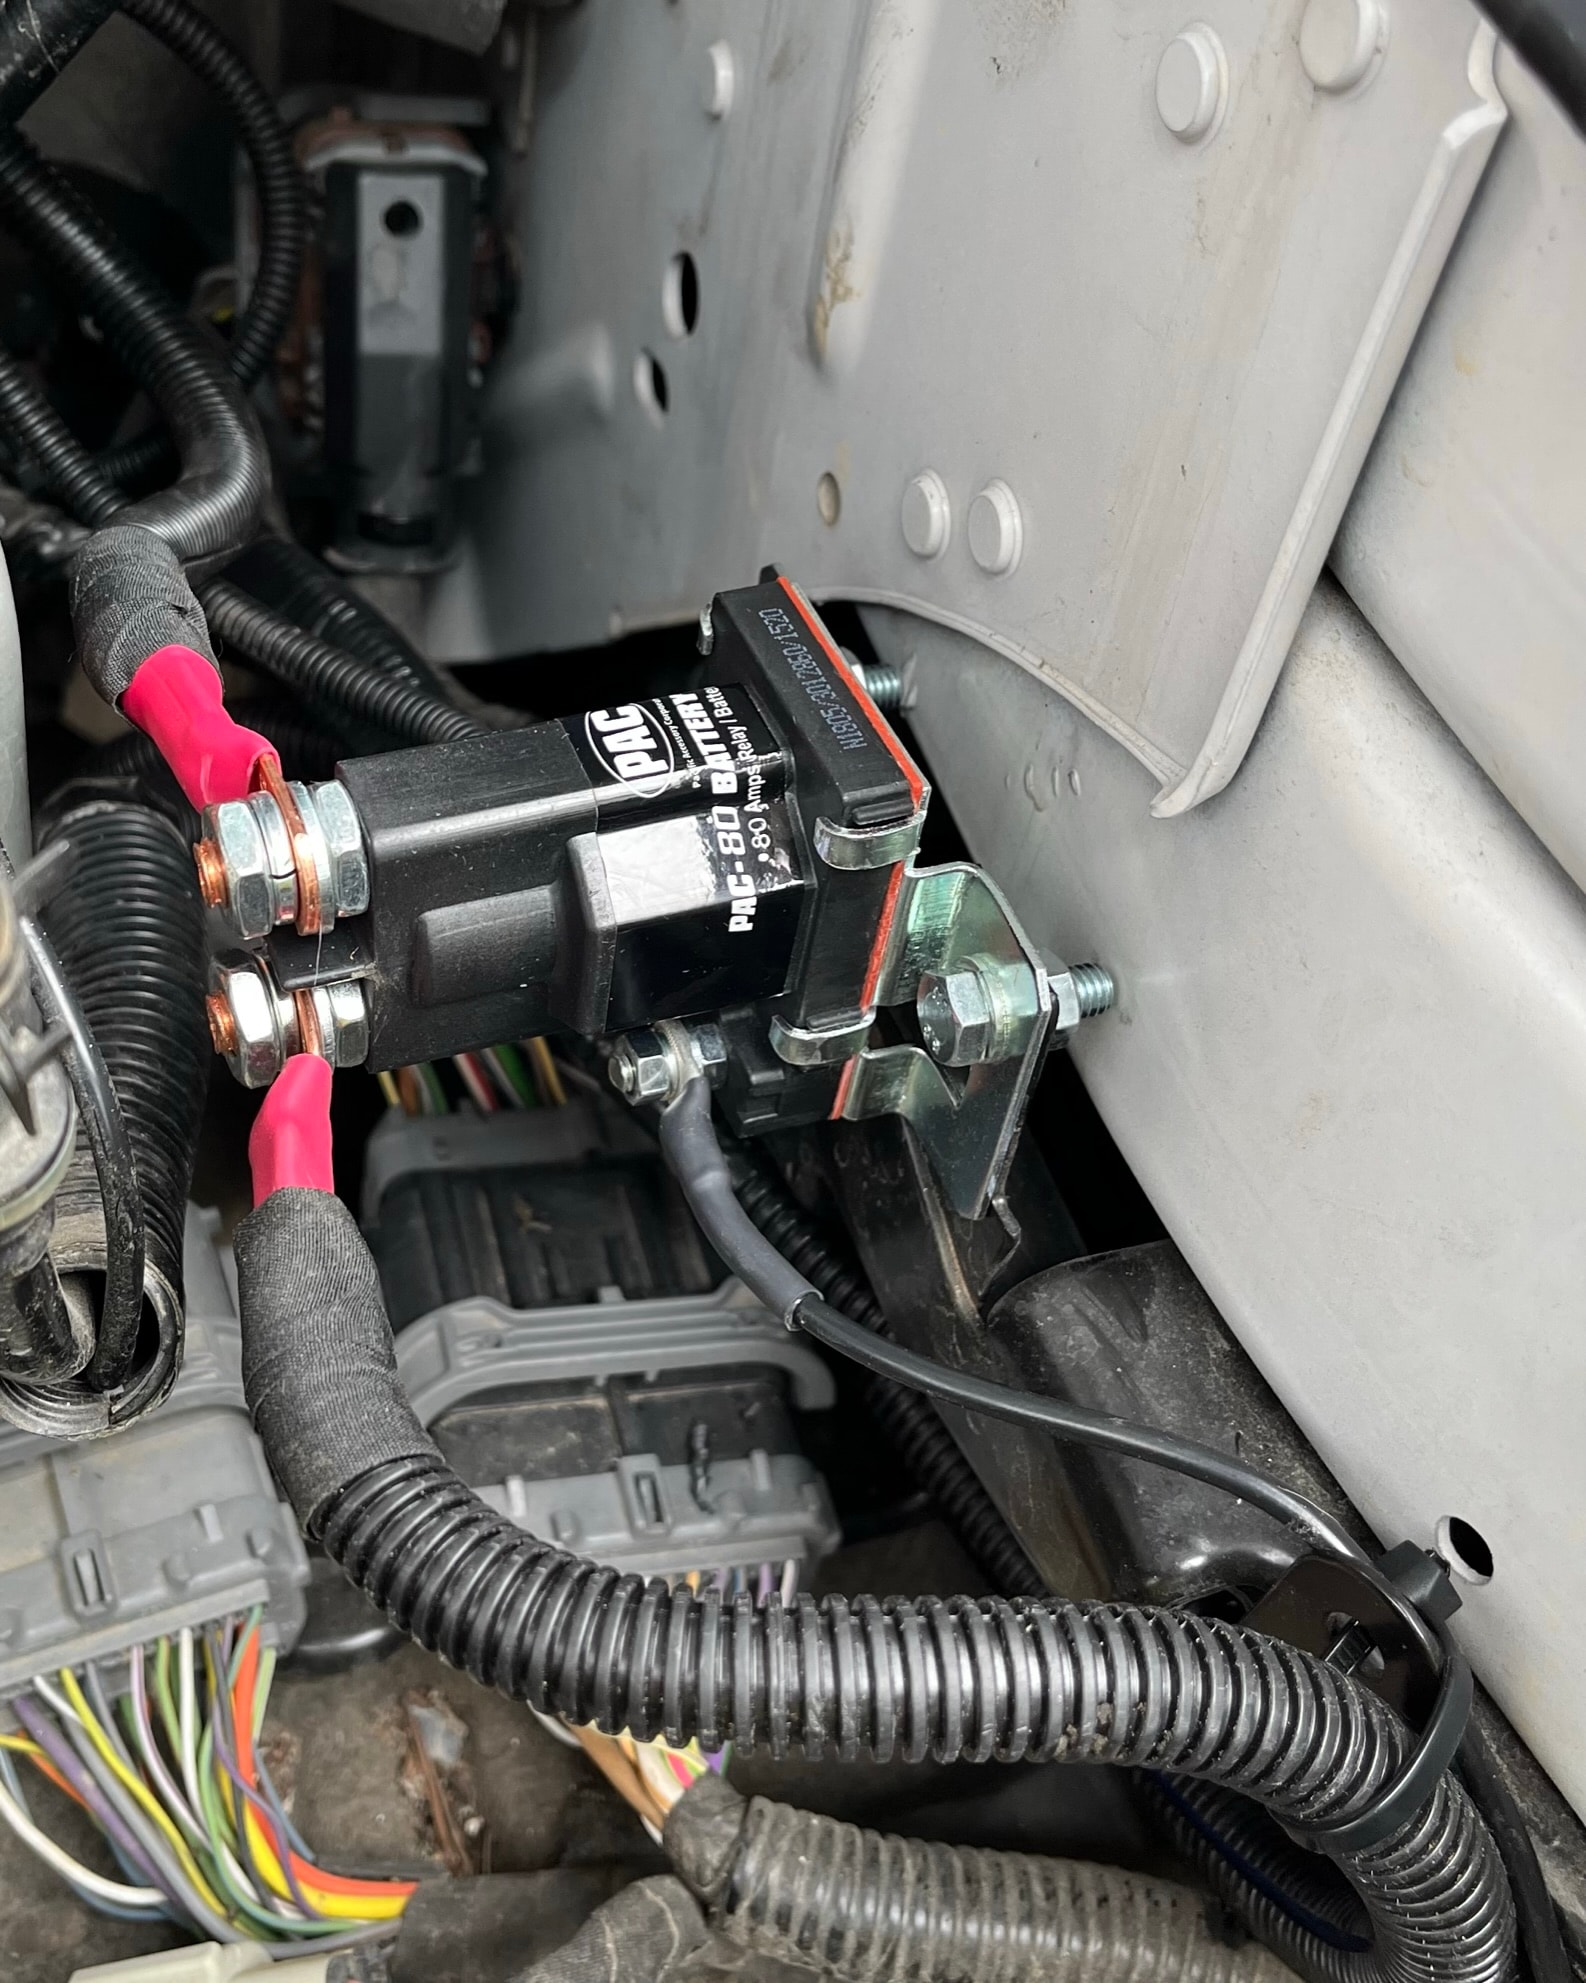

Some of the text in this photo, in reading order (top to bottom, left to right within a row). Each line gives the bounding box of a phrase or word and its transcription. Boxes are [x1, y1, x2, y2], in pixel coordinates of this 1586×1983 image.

[703, 686, 733, 718] Batte
[590, 705, 669, 779] PAC
[669, 725, 692, 759] Accessory
[727, 726, 756, 763] Relay
[743, 764, 767, 813] Amps
[668, 693, 757, 932] PAC-80 BATTERY
[748, 817, 771, 849] 80
